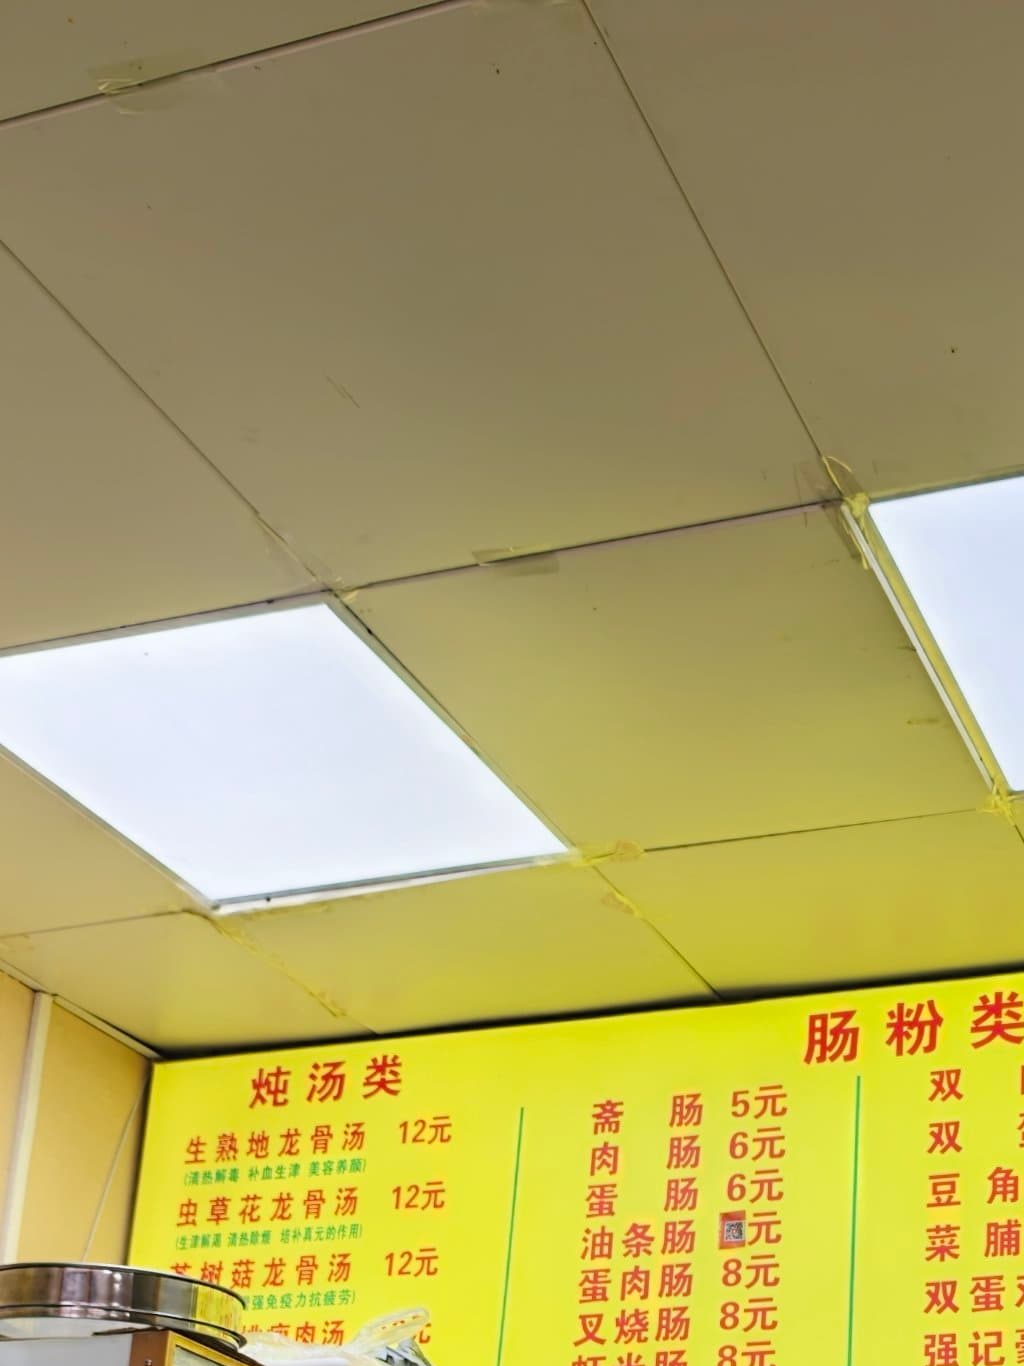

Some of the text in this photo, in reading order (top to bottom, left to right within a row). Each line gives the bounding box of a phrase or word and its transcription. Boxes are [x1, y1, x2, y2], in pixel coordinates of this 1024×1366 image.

[250, 1054, 403, 1109] 炖汤类
[730, 1084, 789, 1119] 5元
[184, 1115, 454, 1165] 生熟地龙骨汤 12元
[728, 1126, 787, 1161] 6元
[175, 1180, 447, 1227] 虫草花龙骨汤 12元
[726, 1168, 784, 1203] 6元
[580, 1219, 697, 1261] 油条肠
[384, 1247, 440, 1278] 12元
[578, 1253, 781, 1304] 蛋肉肠 8元
[245, 1288, 356, 1311] 强免疫力抗疲劳)
[573, 1297, 779, 1348] 叉烧肠 8元
